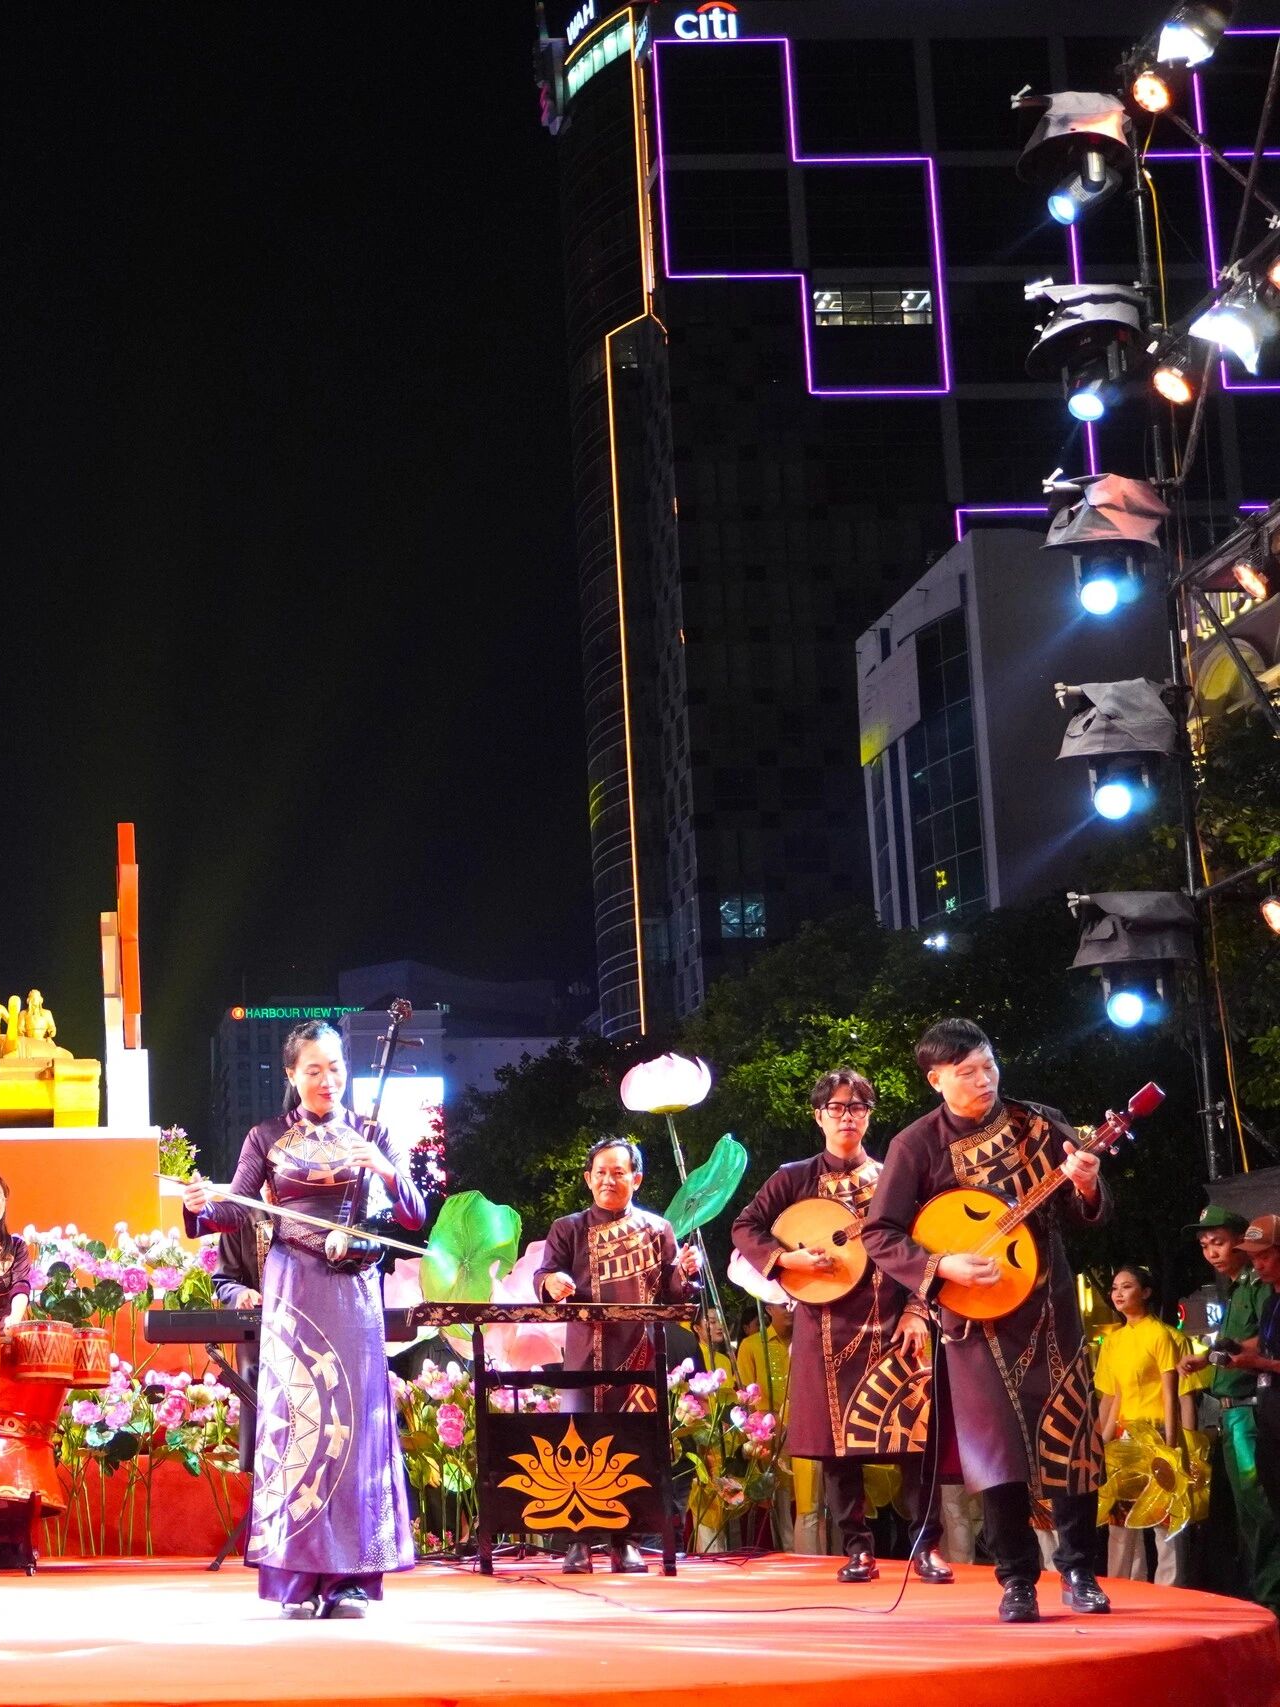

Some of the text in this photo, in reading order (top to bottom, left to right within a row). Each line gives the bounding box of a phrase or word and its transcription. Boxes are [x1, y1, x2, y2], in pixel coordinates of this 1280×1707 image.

[674, 7, 737, 39] citi
[245, 1007, 300, 1018] HARBOUR
[303, 1007, 331, 1018] VIEW
